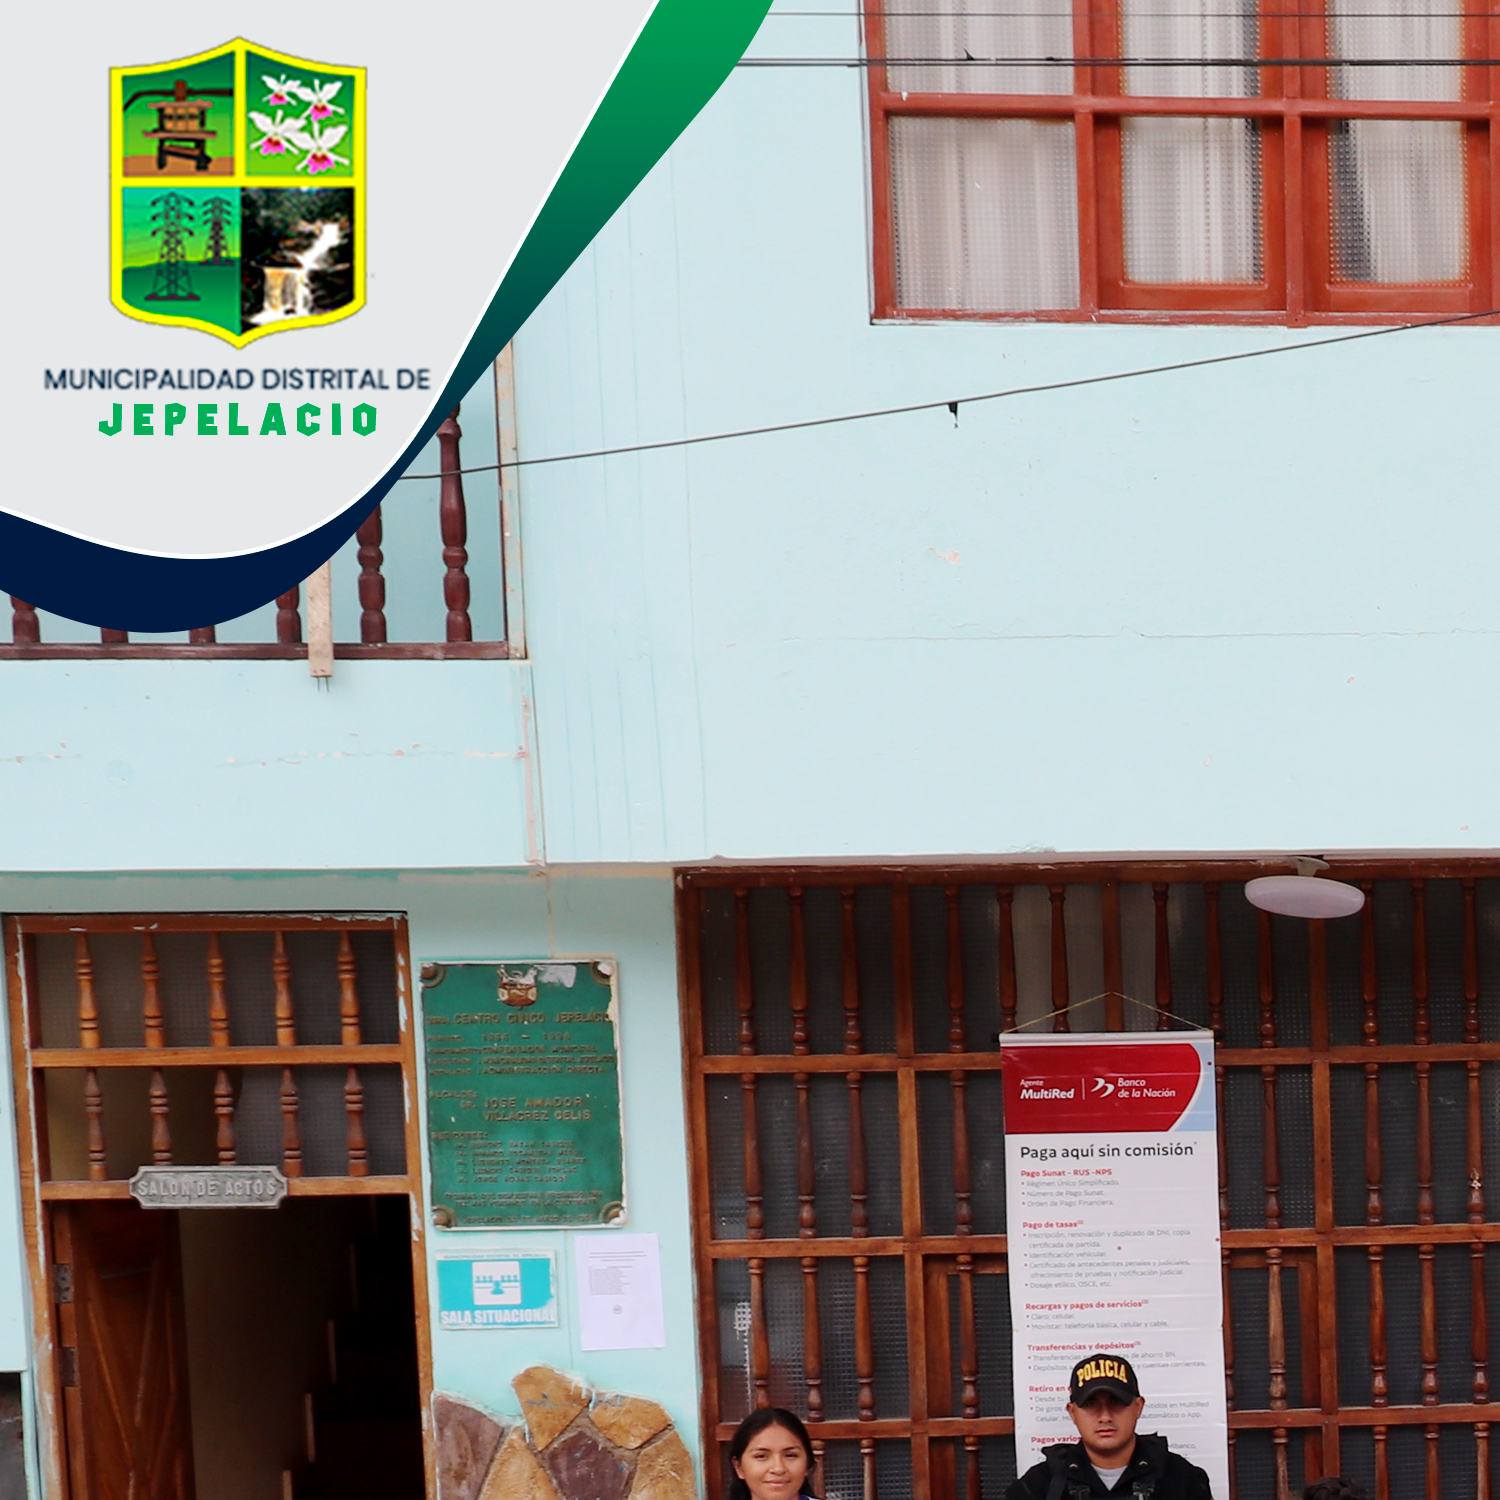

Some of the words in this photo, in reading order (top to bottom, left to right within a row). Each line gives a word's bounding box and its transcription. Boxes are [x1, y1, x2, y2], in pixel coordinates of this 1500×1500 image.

[455, 1013, 500, 1024] CENTRO
[1020, 1079, 1044, 1087] Agente
[1117, 1077, 1146, 1087] Banco
[1020, 1088, 1075, 1099] MultiRed
[1118, 1089, 1130, 1098] de
[1131, 1089, 1141, 1098] la
[1143, 1087, 1176, 1098] Nación
[484, 1098, 517, 1109] JOSE
[525, 1096, 584, 1107] AMADOR
[484, 1110, 550, 1122] VILLACREZ
[554, 1109, 592, 1121] CELIS
[1020, 1146, 1057, 1161] Paga
[1061, 1145, 1094, 1160] aquí
[1099, 1144, 1120, 1157] sin
[1020, 1170, 1040, 1178] Pago
[1042, 1169, 1066, 1177] Sunat
[138, 1180, 191, 1196] SALON
[196, 1179, 220, 1196] DE
[225, 1180, 277, 1195] ACTOS
[1055, 1189, 1064, 1197] de
[1065, 1190, 1082, 1198] Pago
[1049, 1199, 1059, 1207] de
[1060, 1200, 1077, 1208] Pago
[1022, 1222, 1042, 1230] Pago
[1025, 1302, 1062, 1311] Recargas
[1070, 1301, 1094, 1311] pagos
[441, 1310, 472, 1324] SALA
[474, 1308, 557, 1323] SITUACIONAL
[1027, 1342, 1087, 1352] Transferencias
[1076, 1359, 1128, 1387] POLICIA
[1028, 1384, 1054, 1393] Retiro
[1031, 1436, 1055, 1445] Pagos
